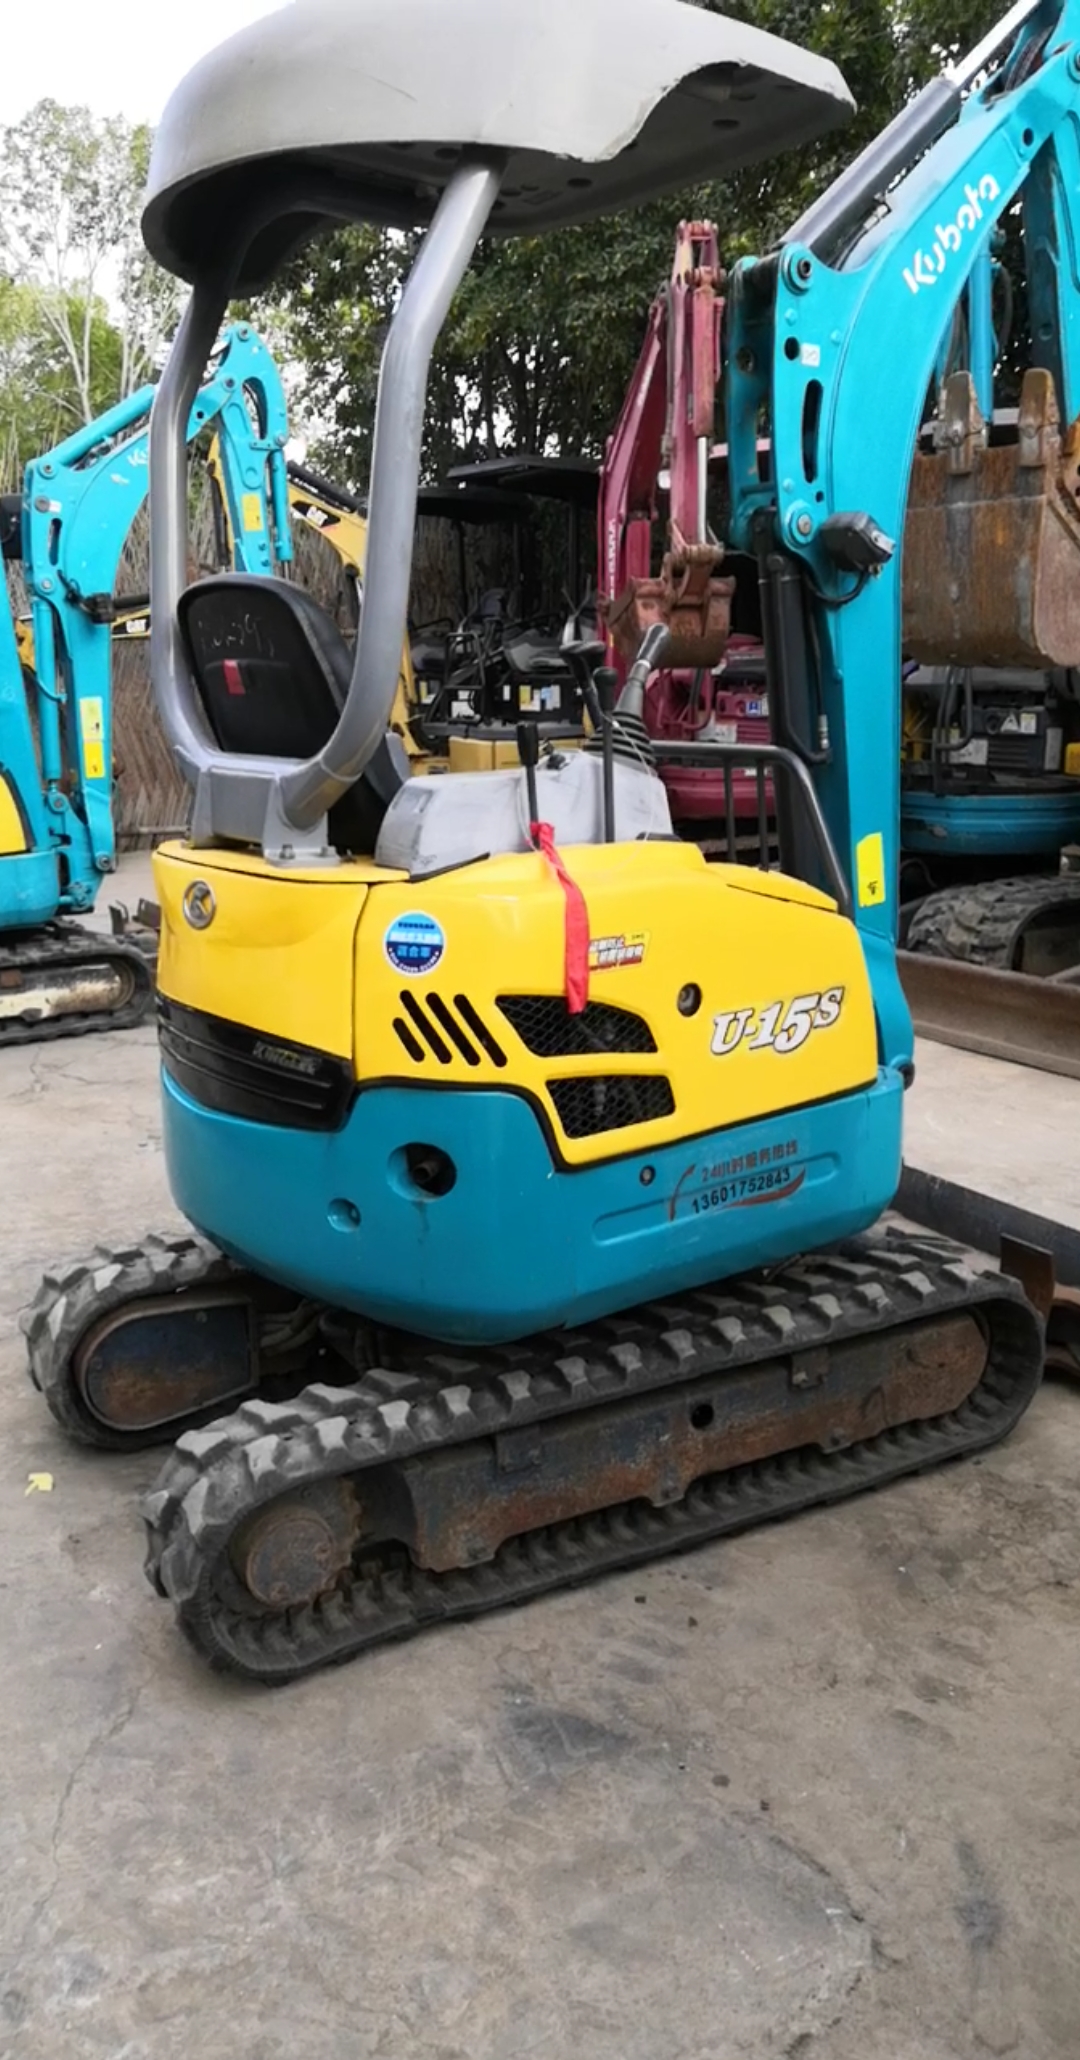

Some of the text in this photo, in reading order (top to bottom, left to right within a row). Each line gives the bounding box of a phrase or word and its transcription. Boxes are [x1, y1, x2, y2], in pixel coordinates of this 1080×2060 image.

[902, 173, 1000, 294] Kubota
[710, 986, 845, 1056] U-15S
[692, 1167, 791, 1214] 13601752843
